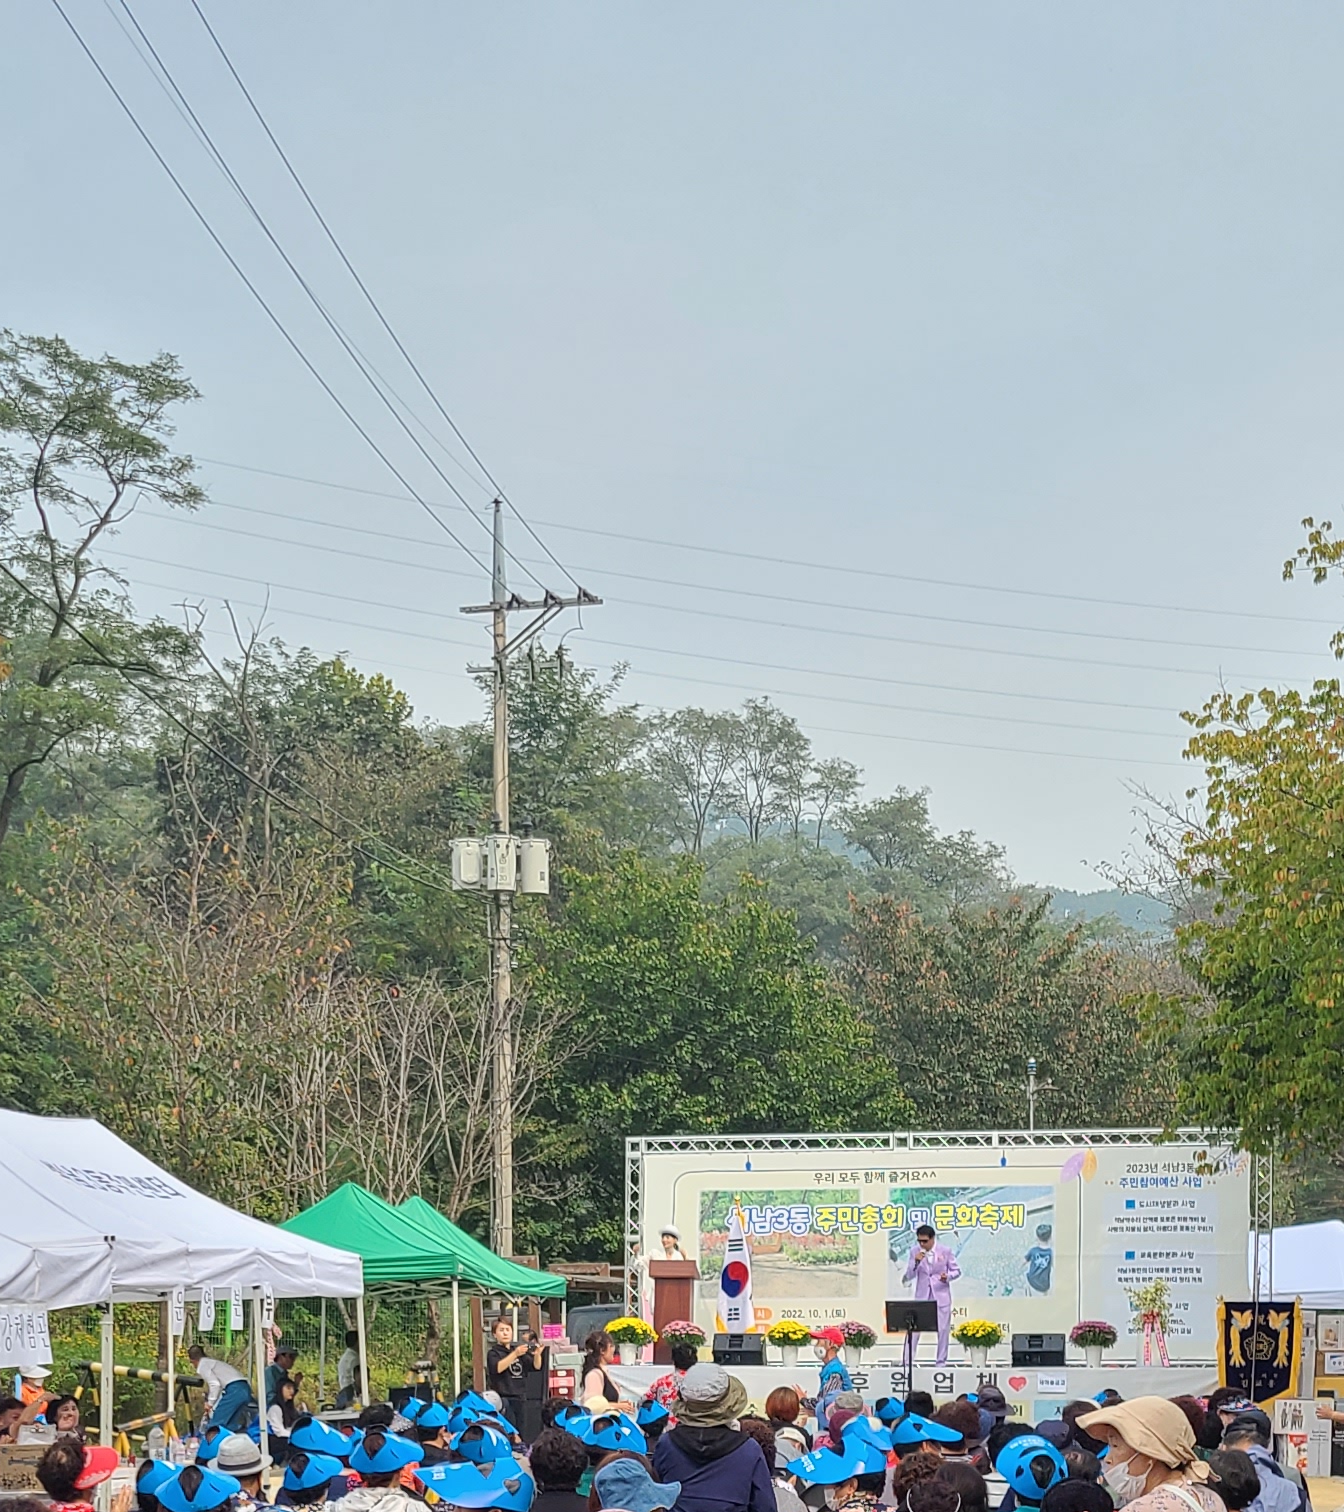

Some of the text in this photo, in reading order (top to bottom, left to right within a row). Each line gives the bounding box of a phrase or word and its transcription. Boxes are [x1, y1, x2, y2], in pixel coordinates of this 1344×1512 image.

[1126, 1163, 1158, 1174] 2023년
[814, 1172, 834, 1184] 우리
[838, 1172, 860, 1183] 모두
[864, 1171, 885, 1184] 함께
[1183, 1176, 1201, 1188] 사업
[816, 1204, 904, 1234] 주민총회
[934, 1204, 1025, 1231] 문화축제
